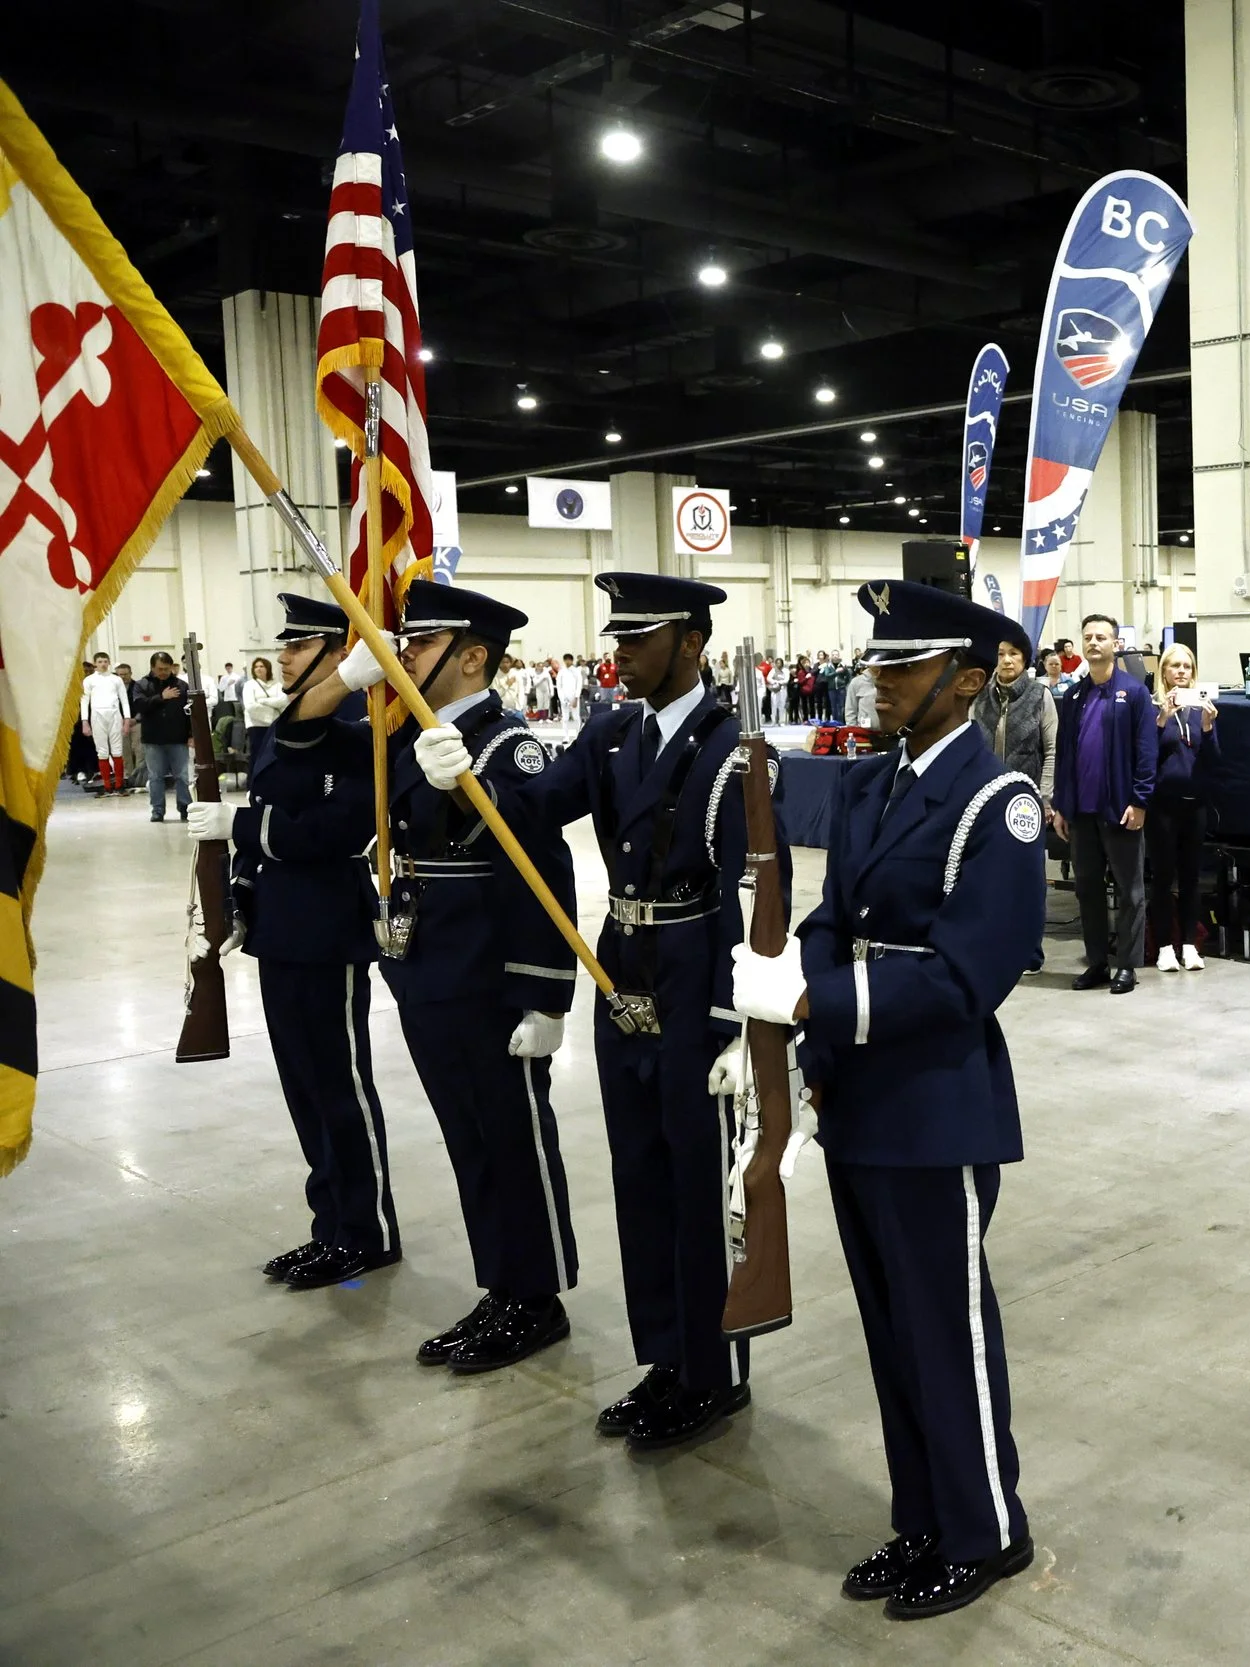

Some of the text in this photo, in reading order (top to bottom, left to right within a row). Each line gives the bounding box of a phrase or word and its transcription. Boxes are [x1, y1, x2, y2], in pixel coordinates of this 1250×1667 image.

[1101, 194, 1170, 254] BC
[1052, 392, 1108, 418] USA
[520, 757, 542, 766] ROTC
[1015, 813, 1035, 822] JUNIOR
[1012, 818, 1036, 830] ROTC
